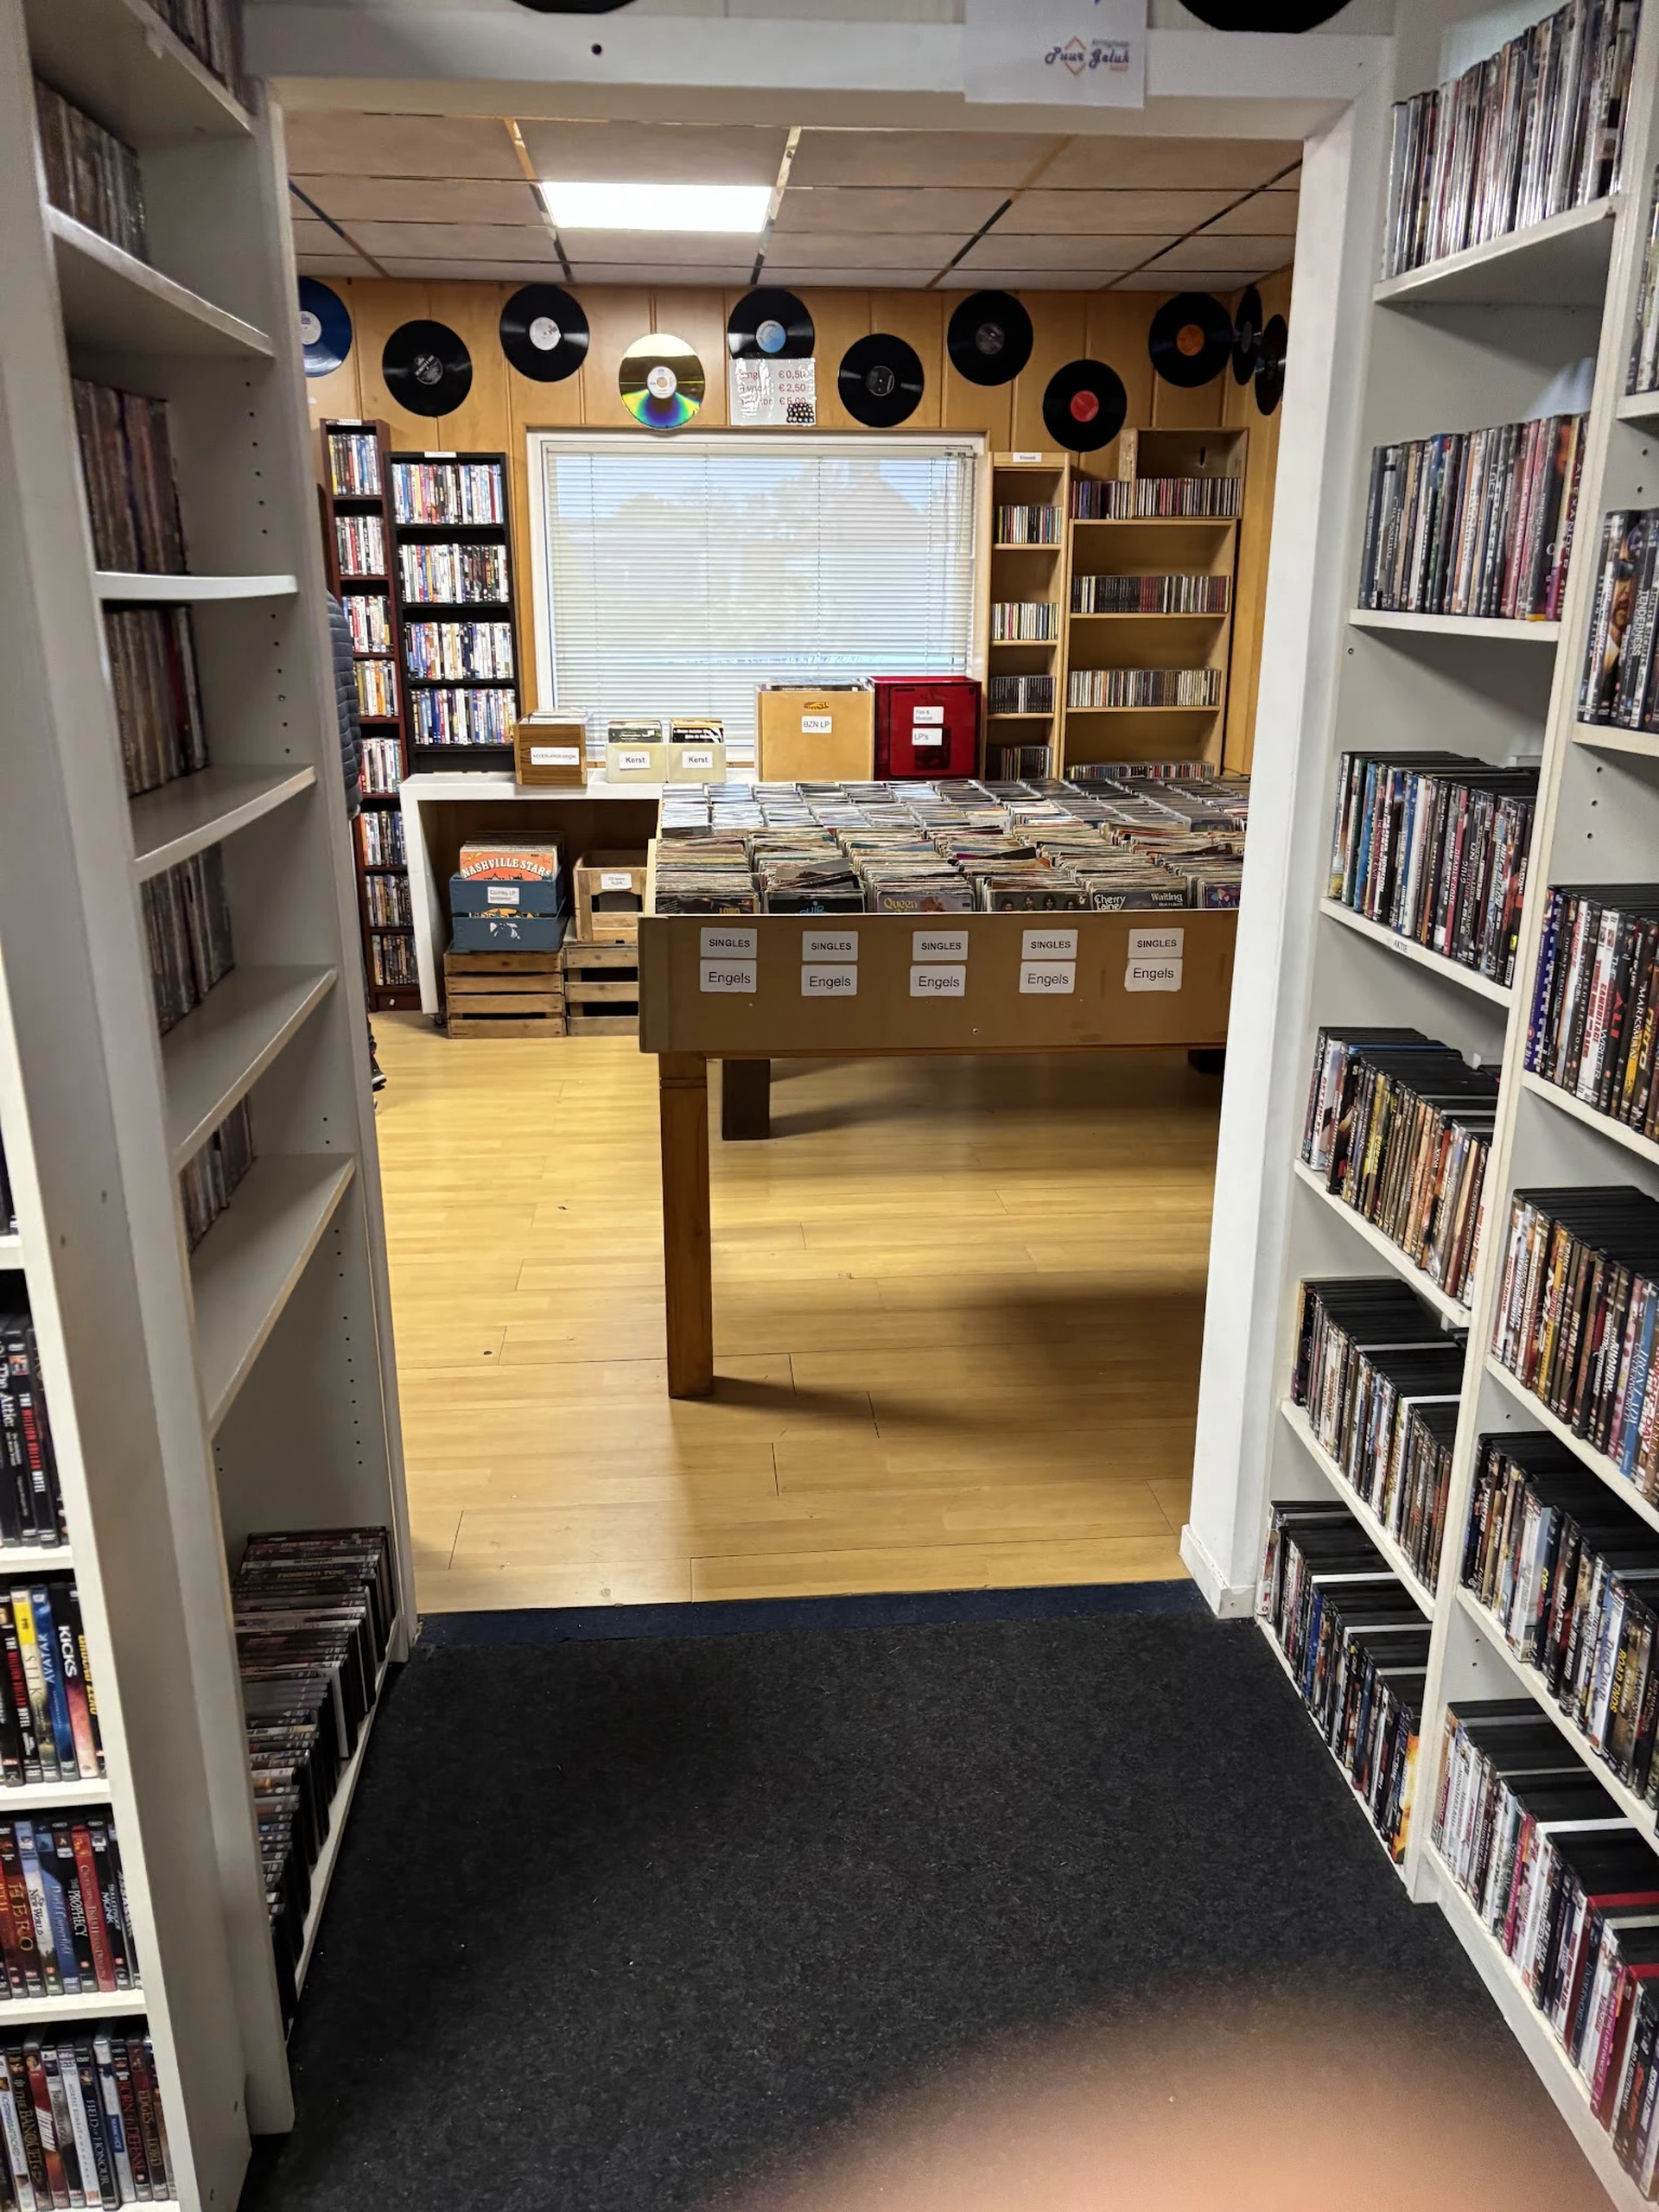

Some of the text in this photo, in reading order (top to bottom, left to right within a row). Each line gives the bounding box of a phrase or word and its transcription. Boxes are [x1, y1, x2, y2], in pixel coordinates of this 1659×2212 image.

[1089, 48, 1128, 68] Geluk
[1632, 588, 1649, 656] TENDERNESS
[461, 857, 554, 878] NASHVILLE STARS
[1379, 855, 1388, 893] HORIZON
[1451, 849, 1459, 881] DEADLY
[883, 898, 918, 910] Queen
[1094, 894, 1127, 907] Cherry
[1151, 893, 1183, 902] Waiting
[709, 938, 750, 948] SINGLES
[810, 942, 852, 950] SINGLES
[921, 942, 962, 950] SINGLES
[1030, 940, 1071, 949] SINGLES
[1136, 939, 1177, 948] SINGLES
[1392, 938, 1408, 953] AKTIE
[1582, 910, 1592, 944] CRADLE
[709, 971, 751, 986] Engels
[809, 976, 851, 989] Engels
[918, 976, 960, 989] Engels
[1027, 973, 1069, 987] Engels
[1133, 968, 1174, 981] Engels
[1555, 977, 1564, 1012] FALLING
[1573, 969, 1591, 1053] RESURRECTION
[1592, 983, 1607, 1044] CAMOUFLAGE
[1593, 955, 1618, 1080] THE WRITER
[1610, 991, 1624, 1039] ALI
[1629, 986, 1647, 1059] MARKSMAN
[1317, 1035, 1326, 1071] SOLARIS
[1639, 1007, 1654, 1071] nitro
[1562, 1243, 1571, 1273] CRADLE
[1515, 1254, 1530, 1331] AMERICAN BEAUTY
[1559, 1285, 1574, 1360] KILLERS
[1592, 1313, 1612, 1396] DOMESTIC DISTURBANCE
[1623, 1342, 1640, 1423] UNDERWORLD
[1628, 1350, 1649, 1426] IRON LADY
[1, 1394, 16, 1427] Attic:
[18, 1393, 32, 1408] THE
[31, 1471, 46, 1493] HOTEL
[1479, 1487, 1491, 1532] TWISTED
[1554, 1583, 1567, 1643] SHADE
[38, 1634, 55, 1684] AVATAR
[59, 1625, 77, 1677] KICKS
[1564, 1650, 1574, 1680] WANTED
[4, 1637, 17, 1650] THE
[18, 1707, 31, 1727] HOTEL
[25, 1656, 43, 1696] SILK
[1609, 1648, 1627, 1713] ROAD ENDS
[8, 1883, 33, 1951] HERO
[29, 1889, 44, 1936] NEW WORLD
[67, 1890, 88, 1937] PROPHECY
[101, 1891, 113, 1924] MONK
[55, 1910, 73, 1955] Copperfield
[1573, 1961, 1593, 2030] UNDERWORLD
[1621, 2043, 1639, 2112] BAD LIEUTENANT
[17, 2091, 40, 2165] THE BANQUET
[36, 2107, 56, 2152] HITMAN
[86, 2100, 109, 2185] FIELD HONOUR
[119, 2080, 144, 2170] BORN DEFENSE
[138, 2090, 161, 2166] EDGES LORD
